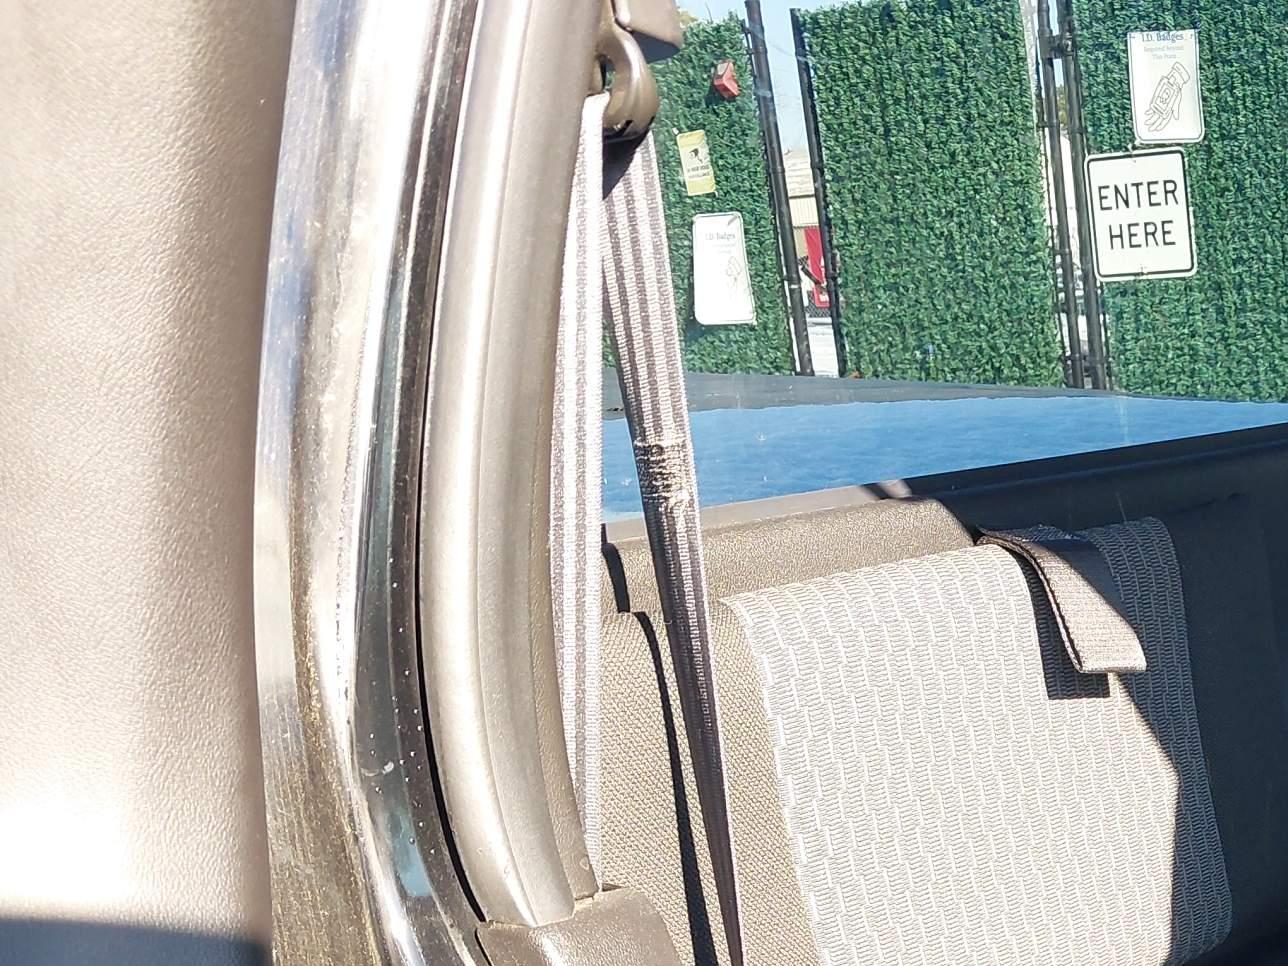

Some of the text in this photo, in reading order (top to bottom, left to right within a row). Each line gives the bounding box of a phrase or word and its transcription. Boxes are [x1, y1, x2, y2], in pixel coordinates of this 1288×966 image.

[1157, 32, 1184, 43] Badges
[1098, 179, 1178, 211] ENTER
[1109, 220, 1176, 250] HERE
